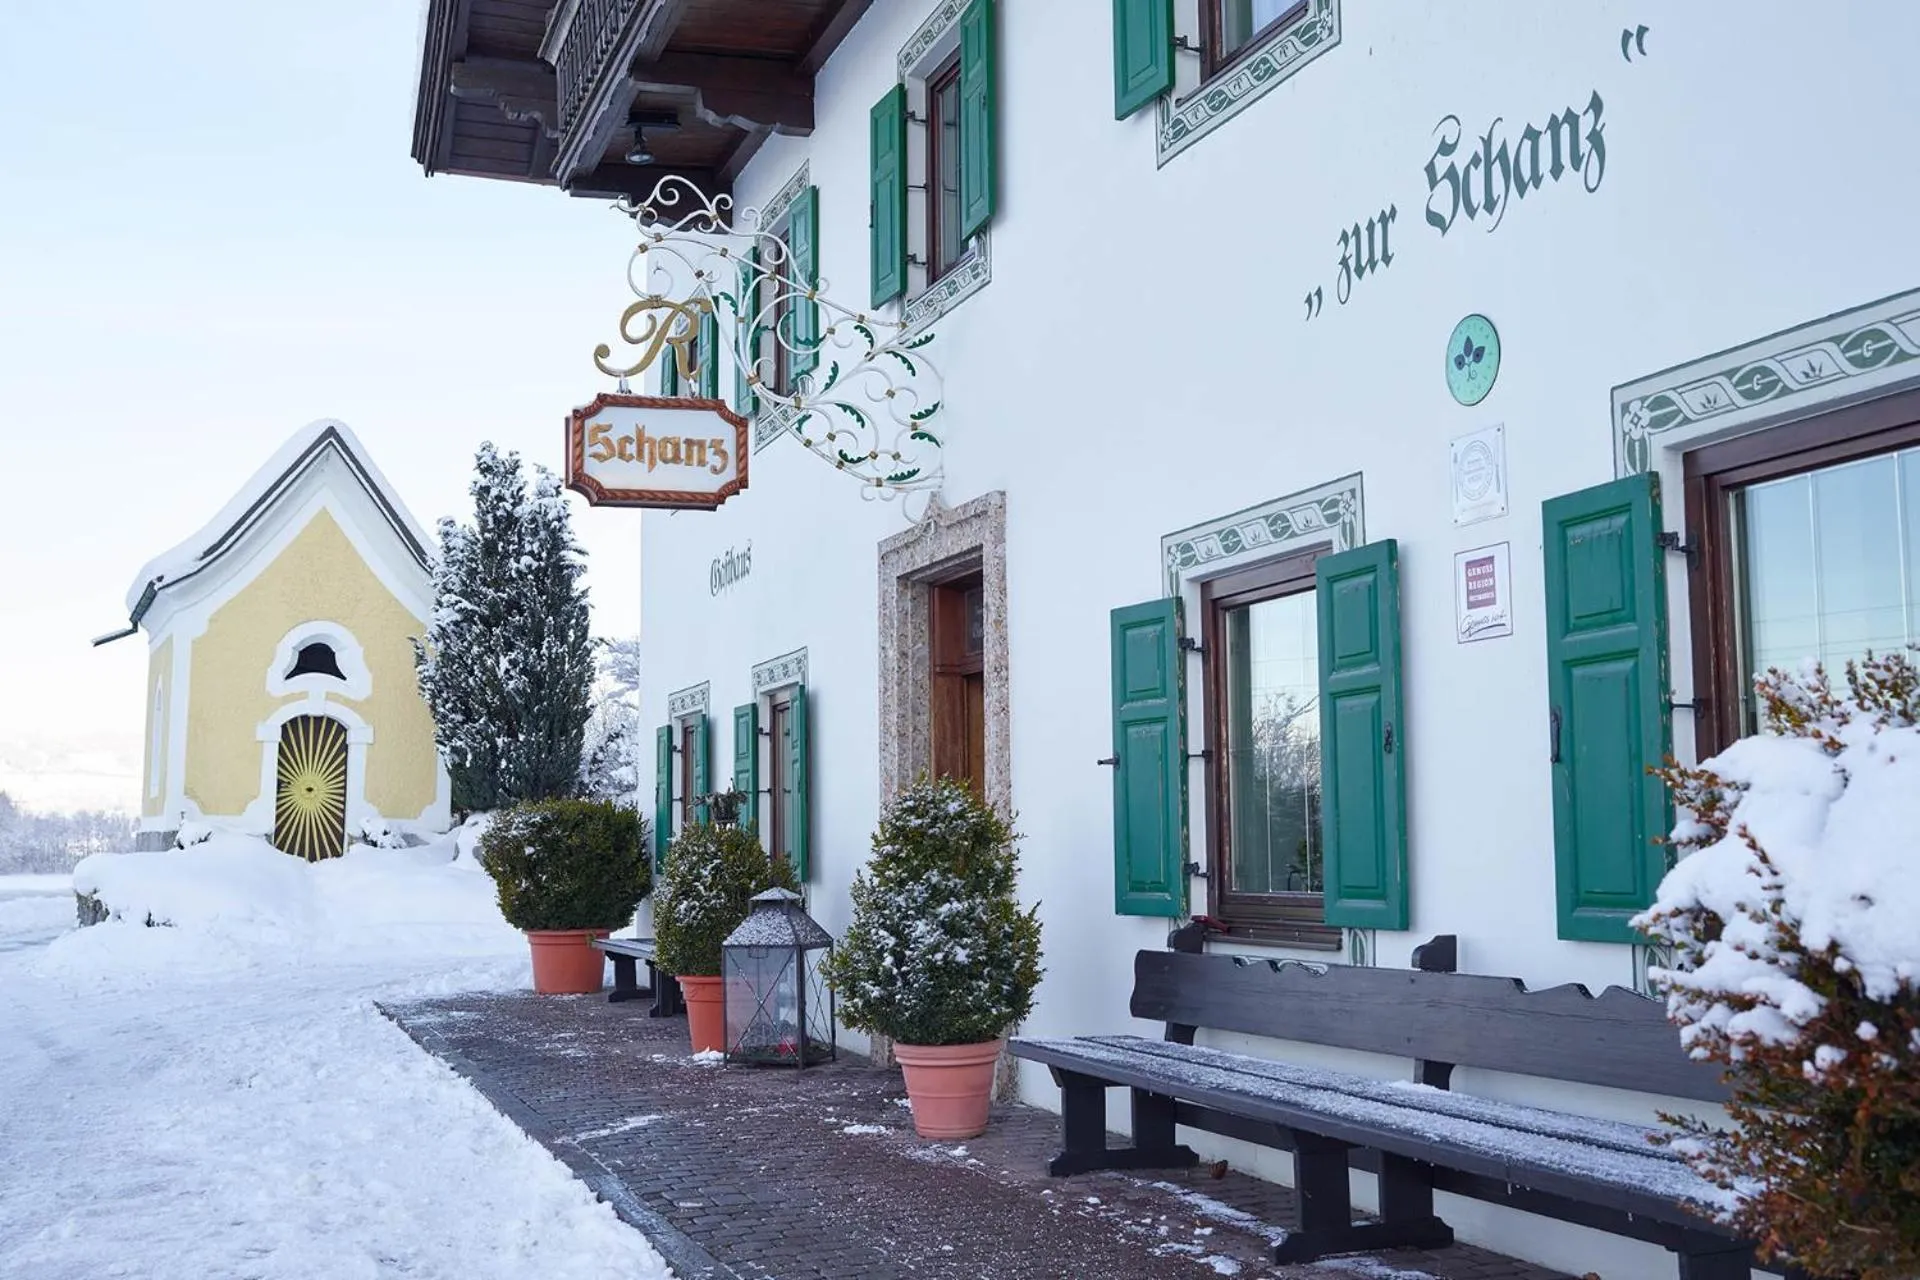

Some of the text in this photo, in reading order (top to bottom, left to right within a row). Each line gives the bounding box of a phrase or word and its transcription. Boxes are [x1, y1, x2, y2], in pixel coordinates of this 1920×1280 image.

[593, 298, 713, 382] R
[588, 423, 729, 476] Schanz
[1467, 563, 1494, 577] GENUSS
[1468, 577, 1495, 591] REGION
